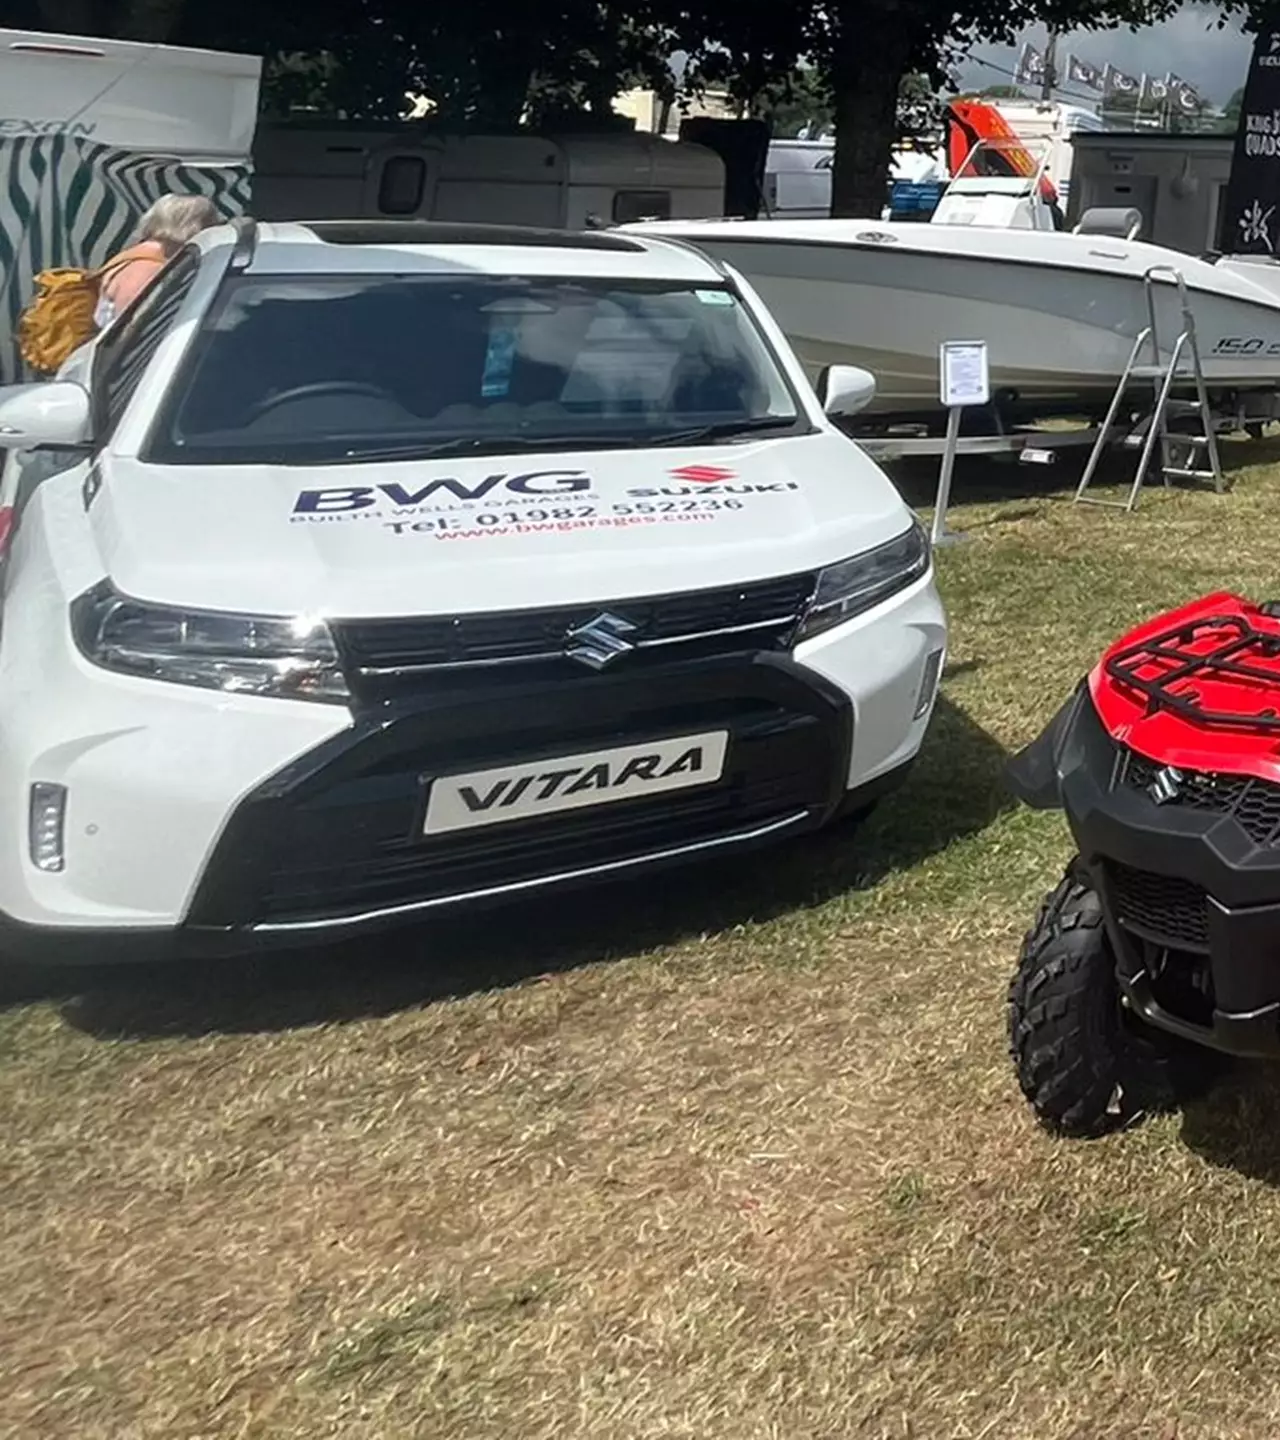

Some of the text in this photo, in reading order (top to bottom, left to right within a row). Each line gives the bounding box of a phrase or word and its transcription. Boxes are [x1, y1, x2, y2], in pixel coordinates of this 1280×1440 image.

[293, 470, 591, 513] BWG
[626, 481, 799, 498] SUZUKI
[289, 493, 600, 523] BUILTH WELLS GARAGES
[383, 498, 745, 534] Tel: 01982 552236
[434, 512, 715, 540] www.bwgarages.com
[458, 747, 703, 812] VITARA
